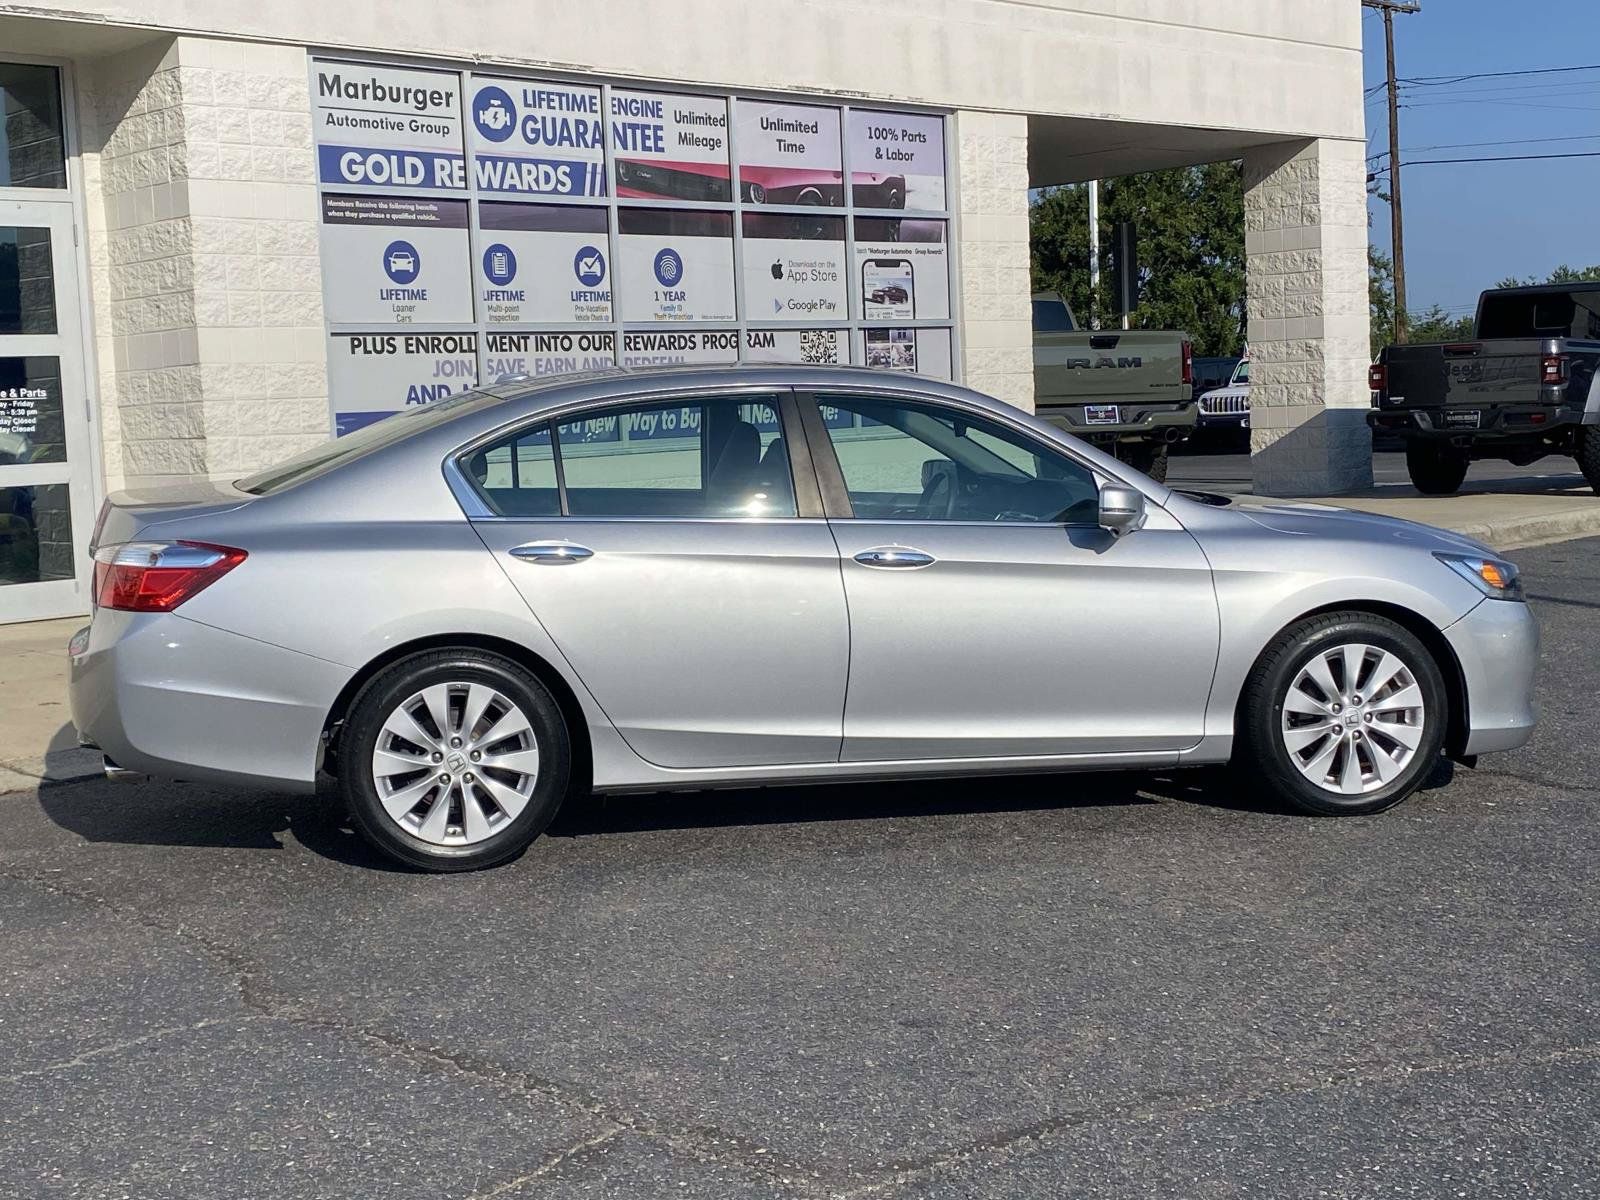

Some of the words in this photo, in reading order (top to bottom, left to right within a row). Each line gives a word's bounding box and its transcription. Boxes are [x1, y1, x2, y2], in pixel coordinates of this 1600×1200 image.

[318, 73, 453, 110] Marburger
[522, 89, 598, 113] LIFETIME
[612, 97, 663, 118] ENGINE
[326, 112, 404, 131] Automotive
[409, 121, 450, 138] Group
[674, 110, 726, 128] Unlimited
[760, 116, 818, 135] Unlimited
[521, 114, 665, 153] GUARANTEE
[868, 126, 898, 142] 100%
[901, 129, 926, 144] Parts
[678, 132, 722, 150] Mileage
[776, 138, 805, 154] Time
[875, 147, 883, 160] &
[886, 149, 914, 162] Labor
[340, 151, 425, 185] GOLD
[434, 157, 572, 193] REWARDS
[327, 199, 354, 208] Members
[355, 200, 377, 209] Receive
[378, 201, 388, 209] the
[389, 202, 415, 211] following
[416, 203, 438, 211] benefits
[345, 210, 358, 219] they
[391, 212, 416, 220] qualified
[788, 259, 817, 268] Download
[828, 260, 836, 268] the
[787, 269, 809, 283] App
[811, 269, 837, 282] Store
[380, 288, 427, 301] LIFETIME
[483, 290, 525, 302] LIFETIME
[571, 291, 611, 302] LIFETIME
[654, 290, 660, 302] 1
[663, 291, 686, 302] YEAR
[392, 304, 416, 313] Loaner
[788, 299, 817, 312] Google
[819, 300, 836, 313] Play
[396, 313, 412, 323] Cars
[489, 314, 519, 323] Inspection
[350, 336, 397, 355] PLUS
[404, 335, 530, 354] ENROLLMENT
[534, 335, 573, 352] INTO
[578, 335, 613, 352] OUR
[623, 334, 697, 351] REWARDS
[702, 332, 775, 351] PROGRAM
[534, 357, 576, 375] EARN
[582, 356, 613, 369] AND
[1067, 357, 1142, 369] RAM
[9, 388, 18, 398] &
[20, 388, 47, 398] Parts
[405, 384, 452, 405] AND
[12, 417, 37, 425] Closed
[585, 416, 617, 433] New
[627, 412, 658, 435] Way
[661, 411, 676, 430] to
[751, 404, 778, 423] Nex
